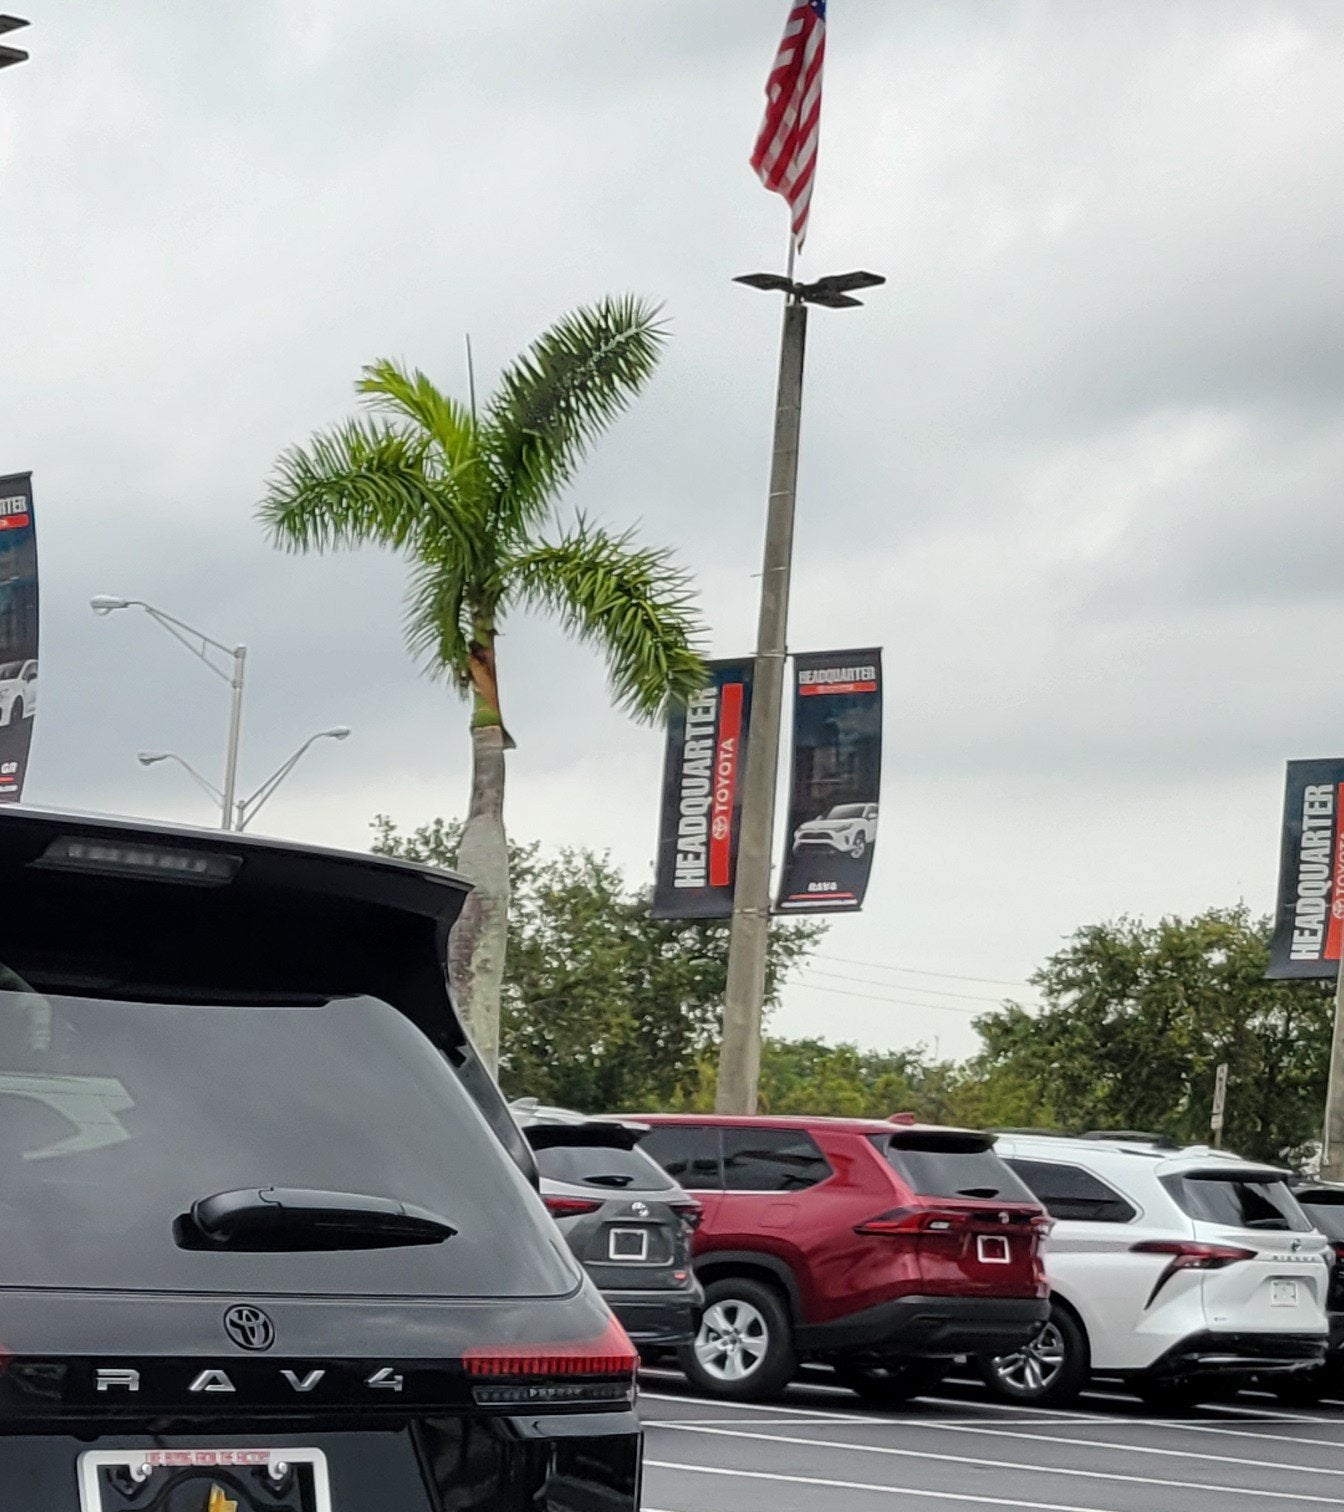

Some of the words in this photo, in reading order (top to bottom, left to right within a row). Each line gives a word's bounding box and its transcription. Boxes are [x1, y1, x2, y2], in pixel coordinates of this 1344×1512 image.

[798, 666, 877, 684] HEADQUARTER
[674, 686, 719, 888] HEADQUARTER
[715, 738, 735, 813] TOYOTA
[1289, 784, 1334, 960] HEADQUARTER
[96, 1367, 404, 1392] RAV4
